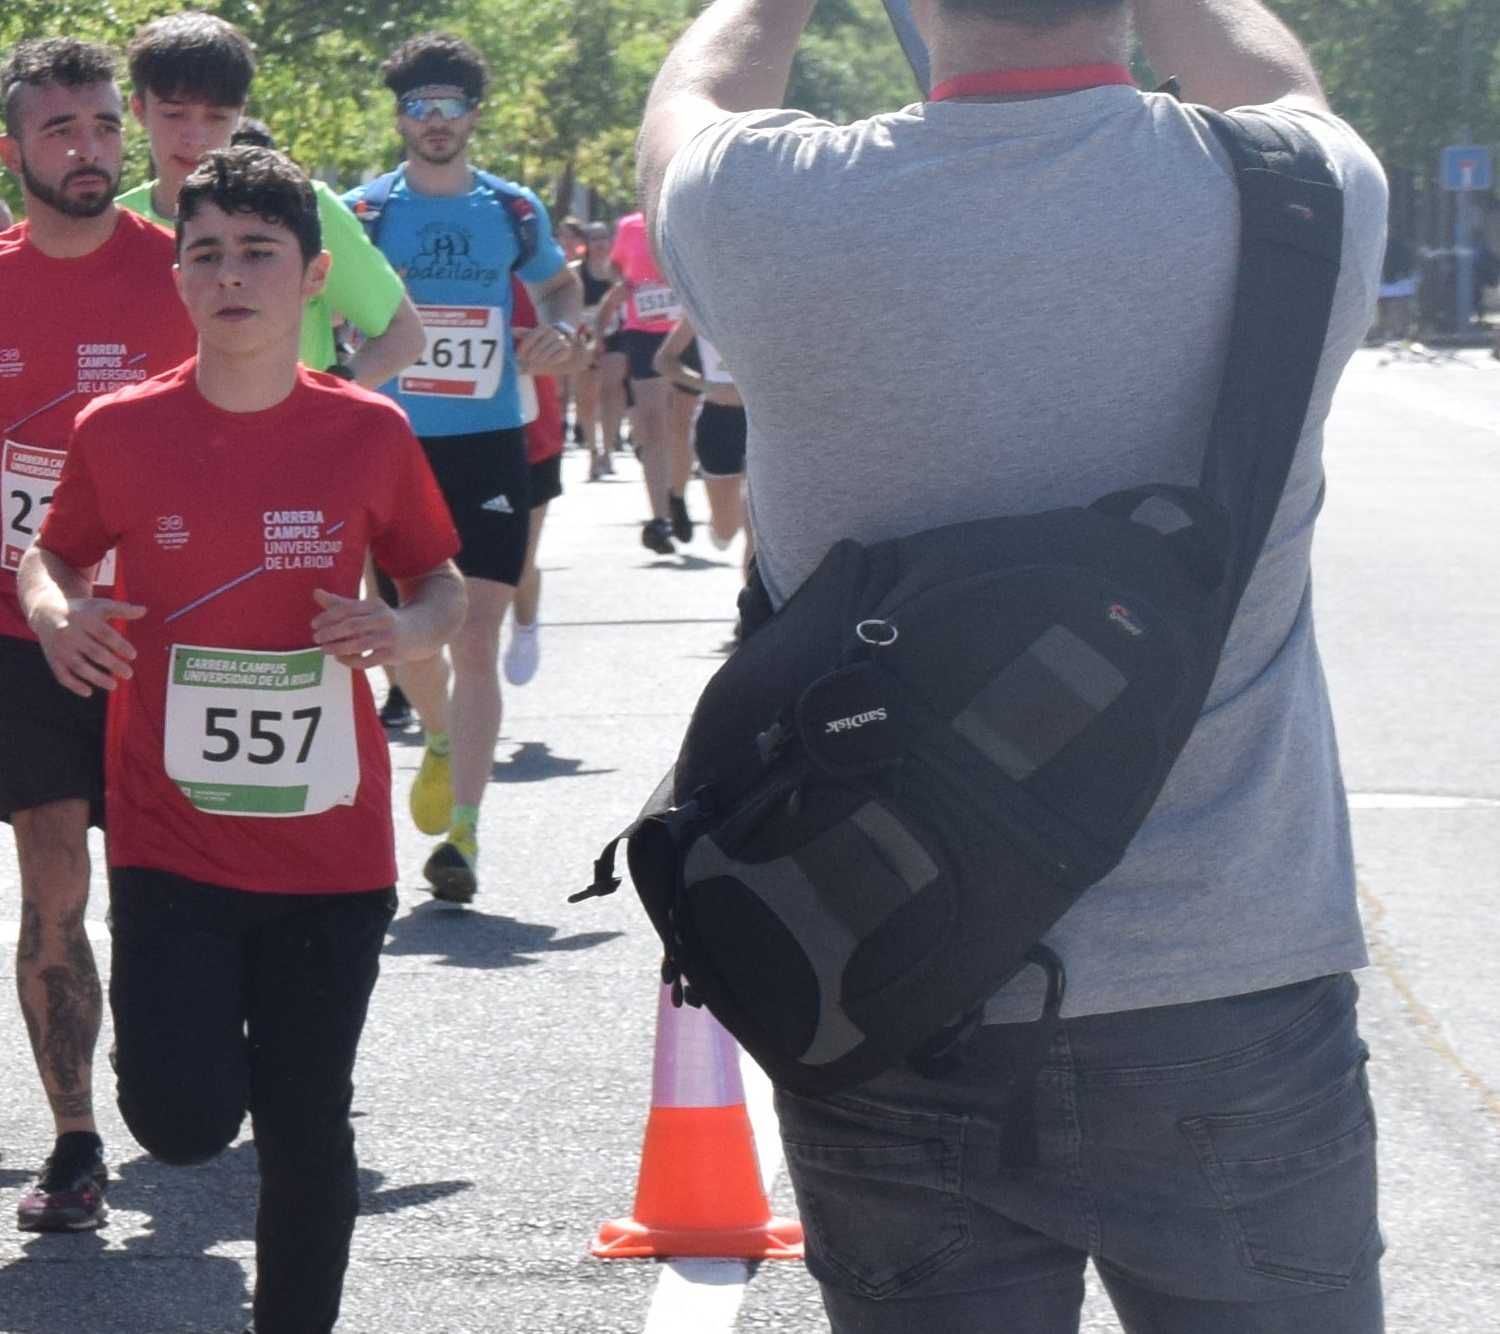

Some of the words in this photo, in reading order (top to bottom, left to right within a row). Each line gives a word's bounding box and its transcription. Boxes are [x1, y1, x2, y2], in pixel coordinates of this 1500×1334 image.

[77, 344, 127, 356] CARRERA
[414, 337, 498, 369] 617
[78, 357, 122, 367] CAMPUS
[78, 369, 146, 380] UNIVERSIDAD
[77, 381, 91, 393] DE
[92, 381, 106, 393] LA
[13, 453, 49, 466] CARRERA
[263, 511, 324, 524] CARRERA
[264, 526, 319, 539] CAMPUS
[264, 541, 342, 554] UNIVERSIDAD
[265, 557, 283, 570] DE
[285, 556, 301, 569] LA
[304, 556, 333, 568] RIOJA
[186, 658, 238, 672] CARRERA
[240, 662, 286, 674] CAMPUS
[183, 670, 256, 685] UNIVERSIDAD
[258, 673, 274, 685] DE
[275, 673, 289, 686] LA
[291, 672, 315, 685] RIOJA
[825, 708, 887, 733] SanDisk
[202, 706, 322, 764] 557
